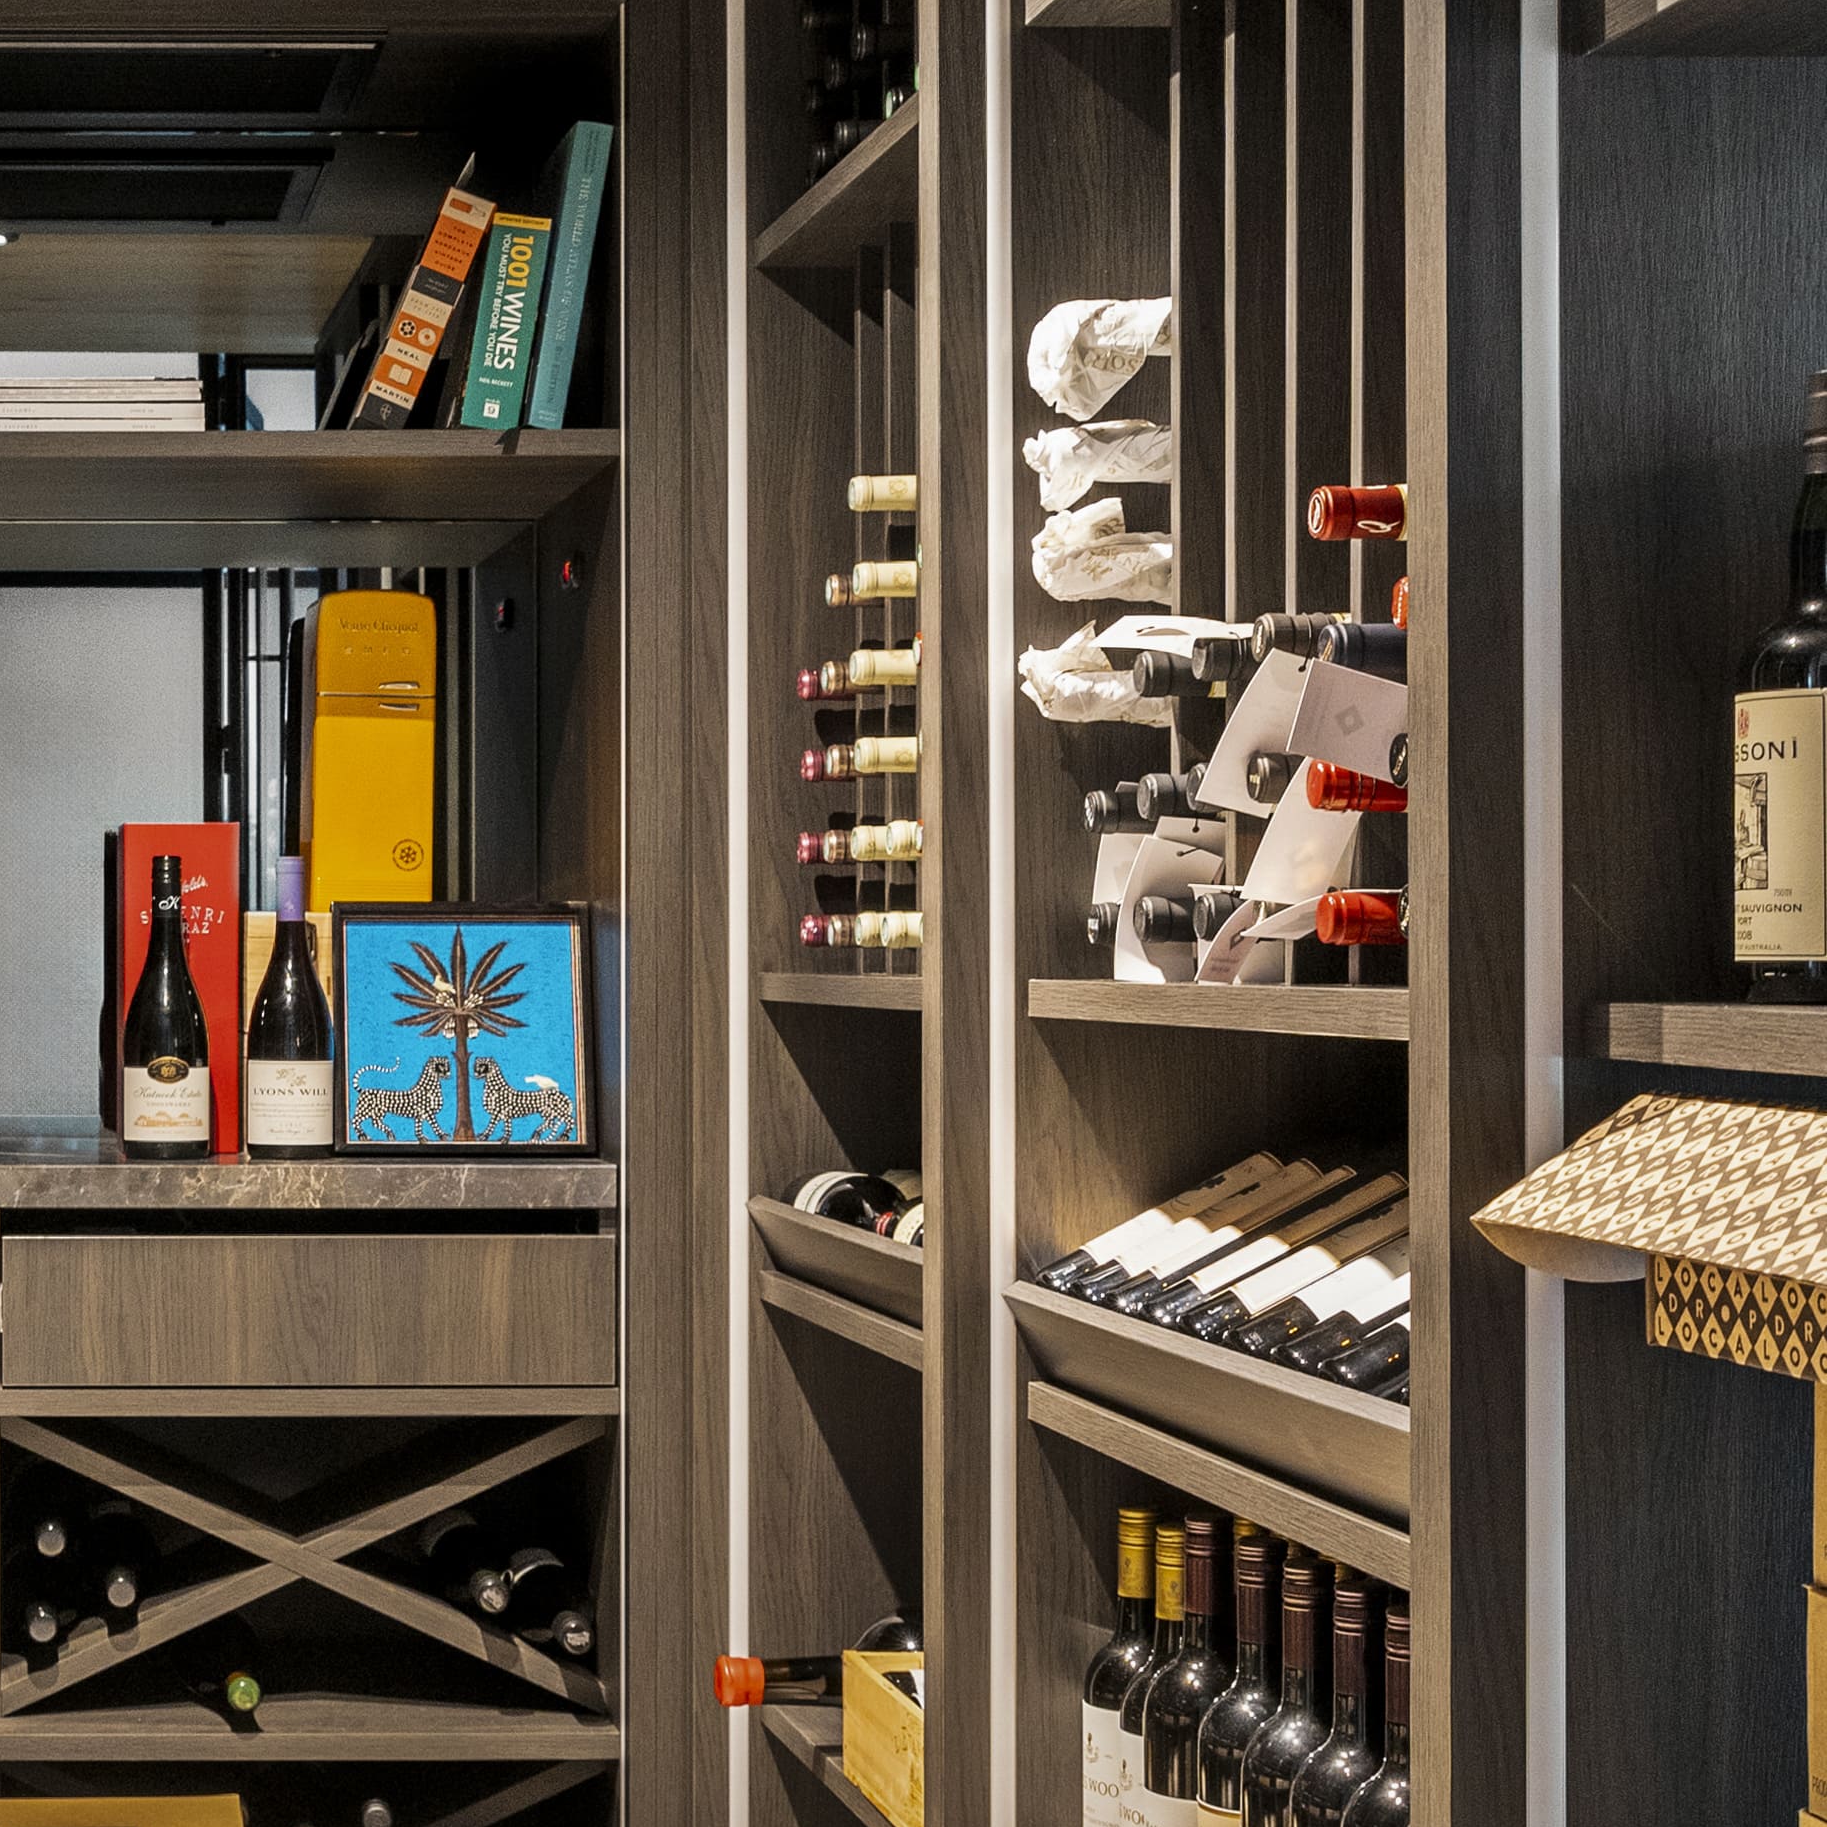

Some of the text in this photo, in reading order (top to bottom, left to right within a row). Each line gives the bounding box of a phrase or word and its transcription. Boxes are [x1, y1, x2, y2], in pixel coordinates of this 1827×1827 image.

[483, 233, 512, 368] YOU MUST TRY BEFORE YOU DIE
[493, 236, 534, 371] 1001 WINES
[397, 347, 421, 363] NEAL
[375, 384, 410, 404] MARTIN
[339, 618, 370, 631] Veuve
[1741, 904, 1803, 914] SAUVIGNON
[253, 1087, 329, 1097] LYONS WILL
